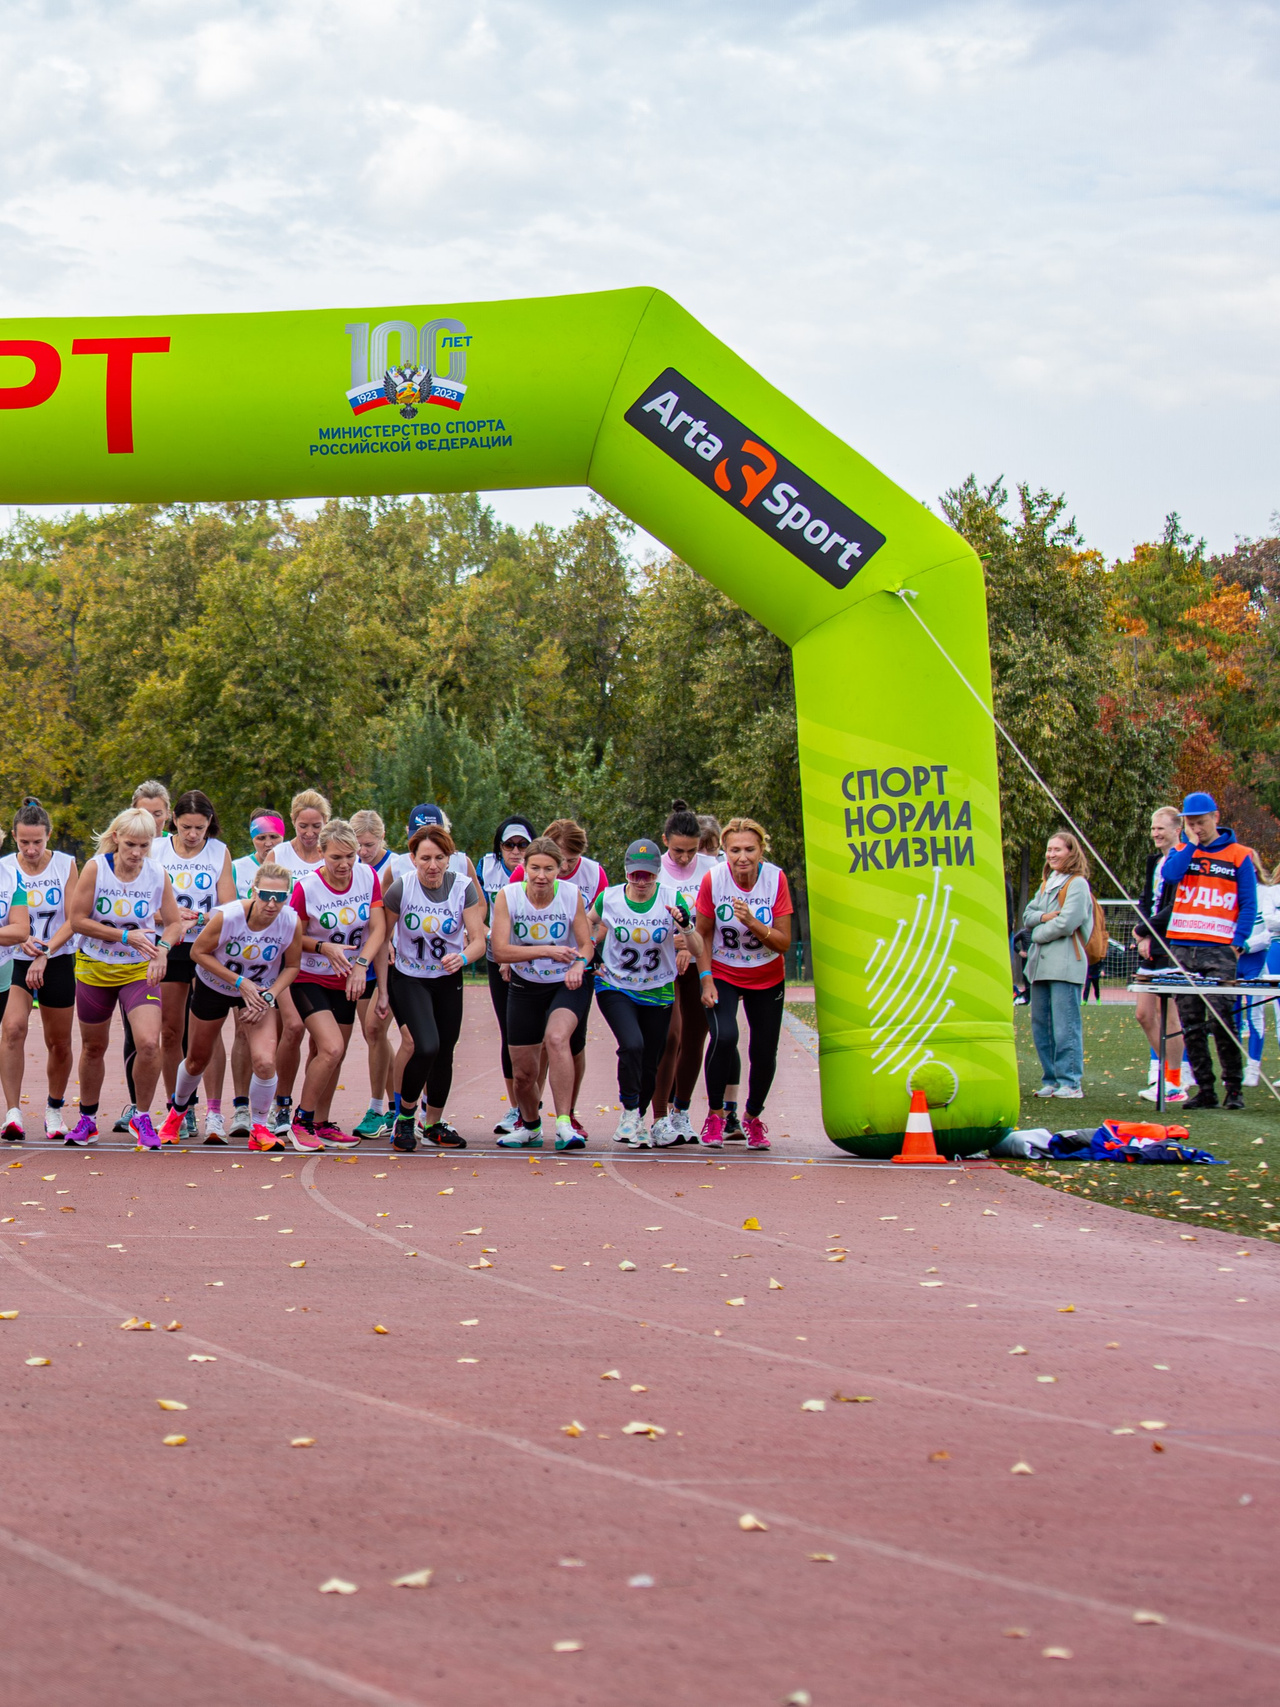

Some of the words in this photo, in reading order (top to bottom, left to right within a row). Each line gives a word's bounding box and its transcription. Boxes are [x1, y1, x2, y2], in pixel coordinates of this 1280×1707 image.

[441, 336, 473, 348] ЛЕТ
[357, 390, 378, 404] 1923
[434, 387, 458, 400] 2023
[318, 422, 441, 440] МИНИСТЕРСТВО
[445, 419, 505, 434] СПОРТА
[309, 437, 411, 456] РОССИЙСКОЙ
[415, 435, 513, 452] ФЕДЕРАЦИИ
[641, 390, 723, 462] Arta
[761, 482, 862, 571] Sport
[841, 765, 948, 802] СПОРТ
[844, 800, 972, 838] НОРМА
[847, 836, 975, 874] ЖИЗНИ
[164, 863, 212, 871] MARAFONE
[1210, 863, 1235, 876] Sport
[25, 878, 61, 889] RAFONE
[316, 892, 370, 912] VMARAFONE
[613, 917, 671, 926] VMARAFONE
[411, 935, 447, 960] 18
[720, 925, 764, 951] 83
[621, 947, 662, 973] 23
